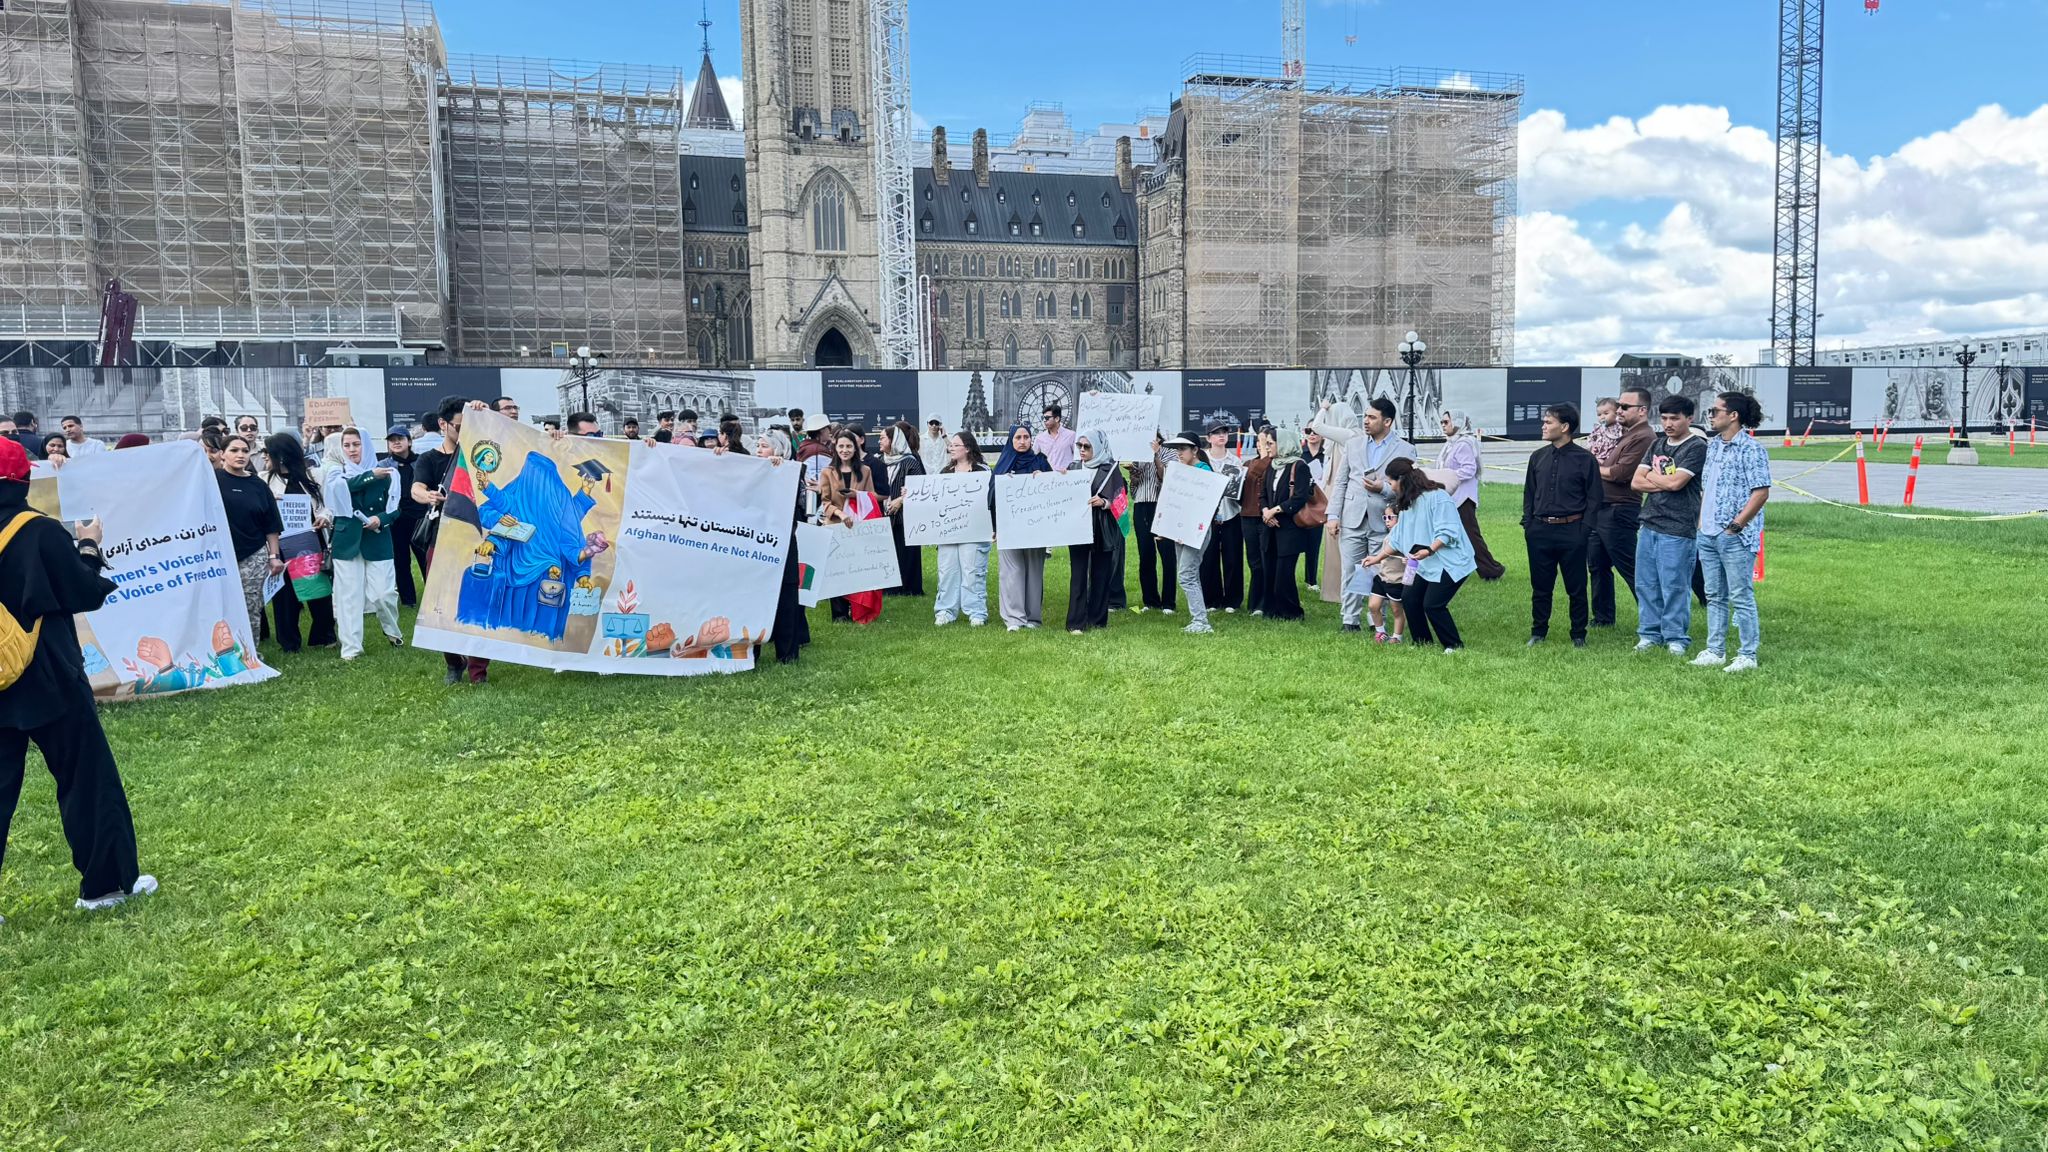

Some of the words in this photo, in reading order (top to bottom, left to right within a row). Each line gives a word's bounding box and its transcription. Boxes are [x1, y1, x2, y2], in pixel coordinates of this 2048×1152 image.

[631, 510, 676, 525] نیستند
[678, 514, 698, 528] تنها
[700, 519, 754, 540] افغانستان
[756, 531, 779, 547] زنان
[106, 538, 133, 559] آزادی
[136, 534, 172, 552] صدای
[625, 527, 666, 542] Afghan
[668, 534, 709, 550] Women
[710, 542, 729, 554] Are
[730, 546, 750, 558] Not
[750, 550, 780, 564] Alone
[118, 582, 164, 600] Voice
[167, 574, 183, 588] of
